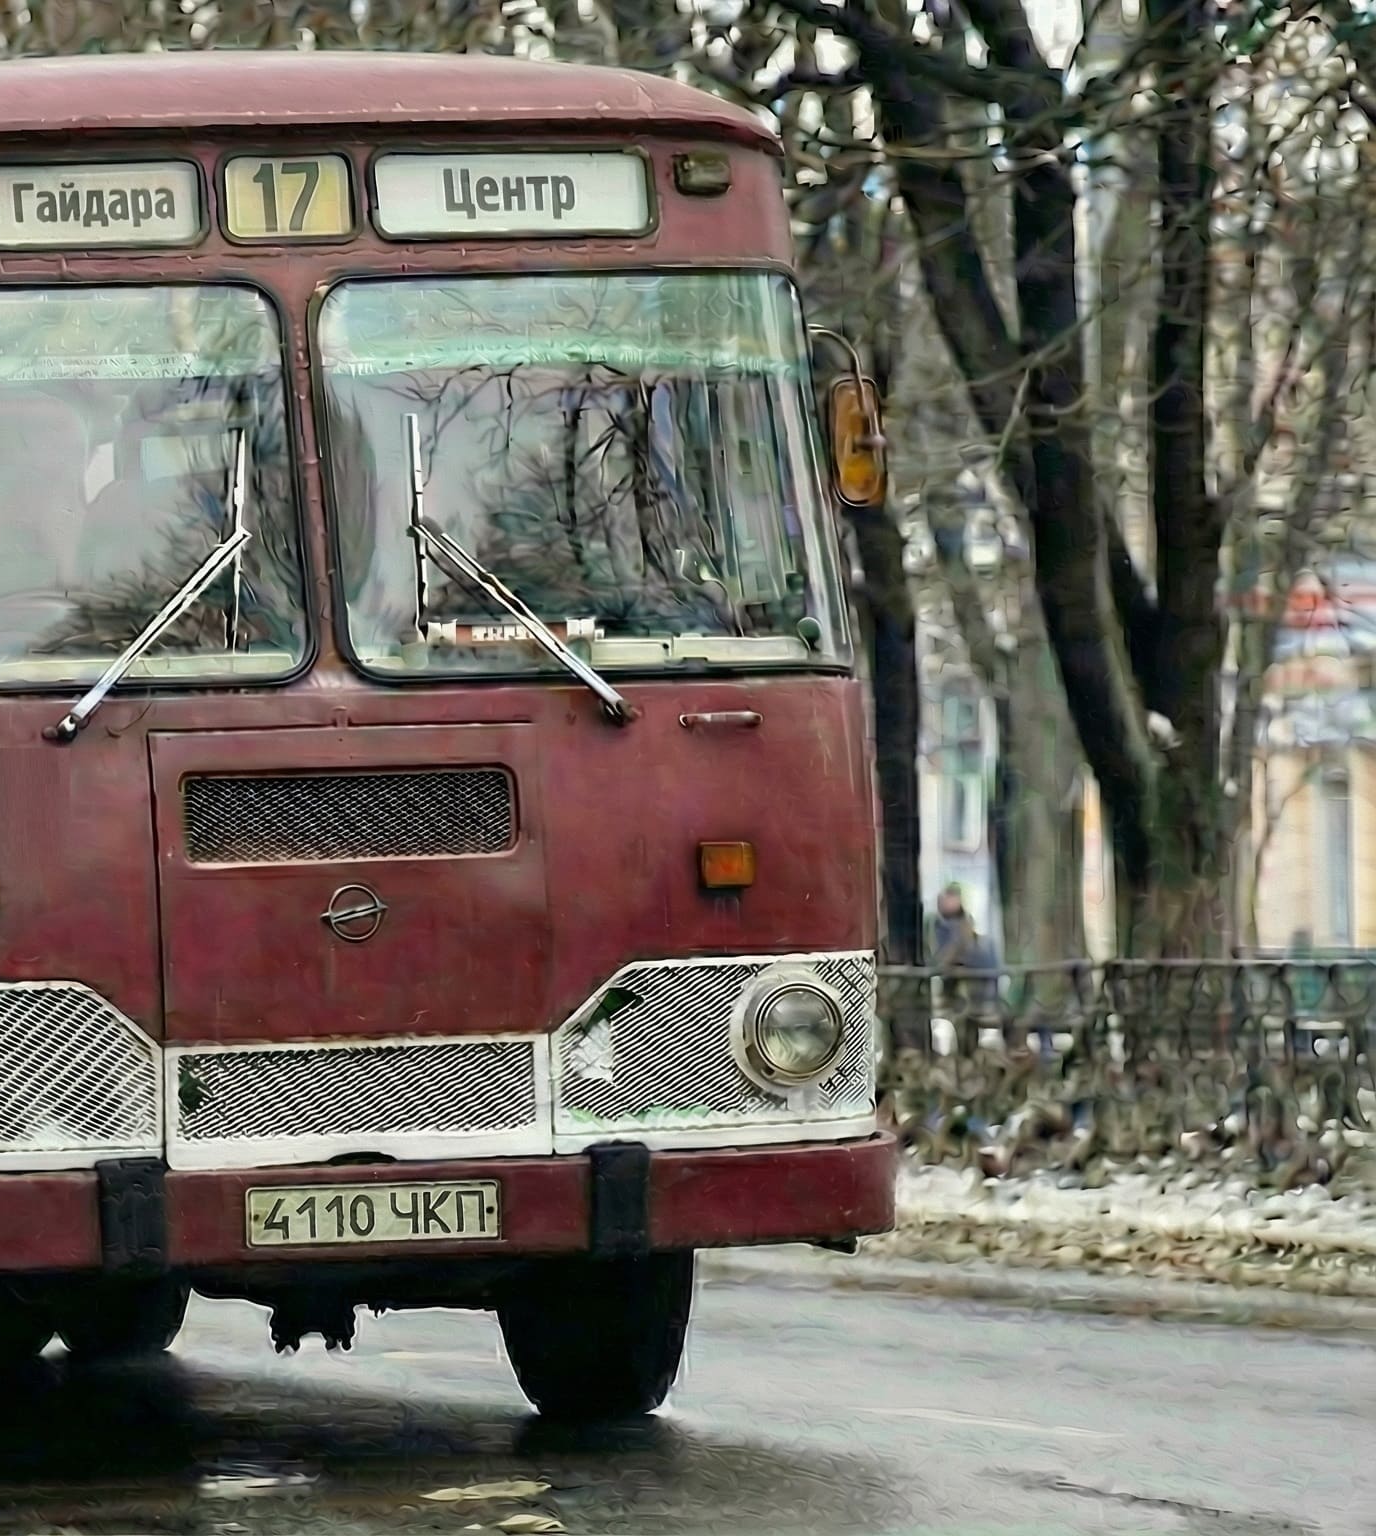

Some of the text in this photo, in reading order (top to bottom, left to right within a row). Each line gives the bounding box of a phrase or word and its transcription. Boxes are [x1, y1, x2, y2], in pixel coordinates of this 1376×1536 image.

[12, 181, 177, 226] Гайдара
[253, 161, 321, 233] 17
[442, 168, 577, 220] Центр
[263, 1189, 486, 1240] 4110 ЧКП
